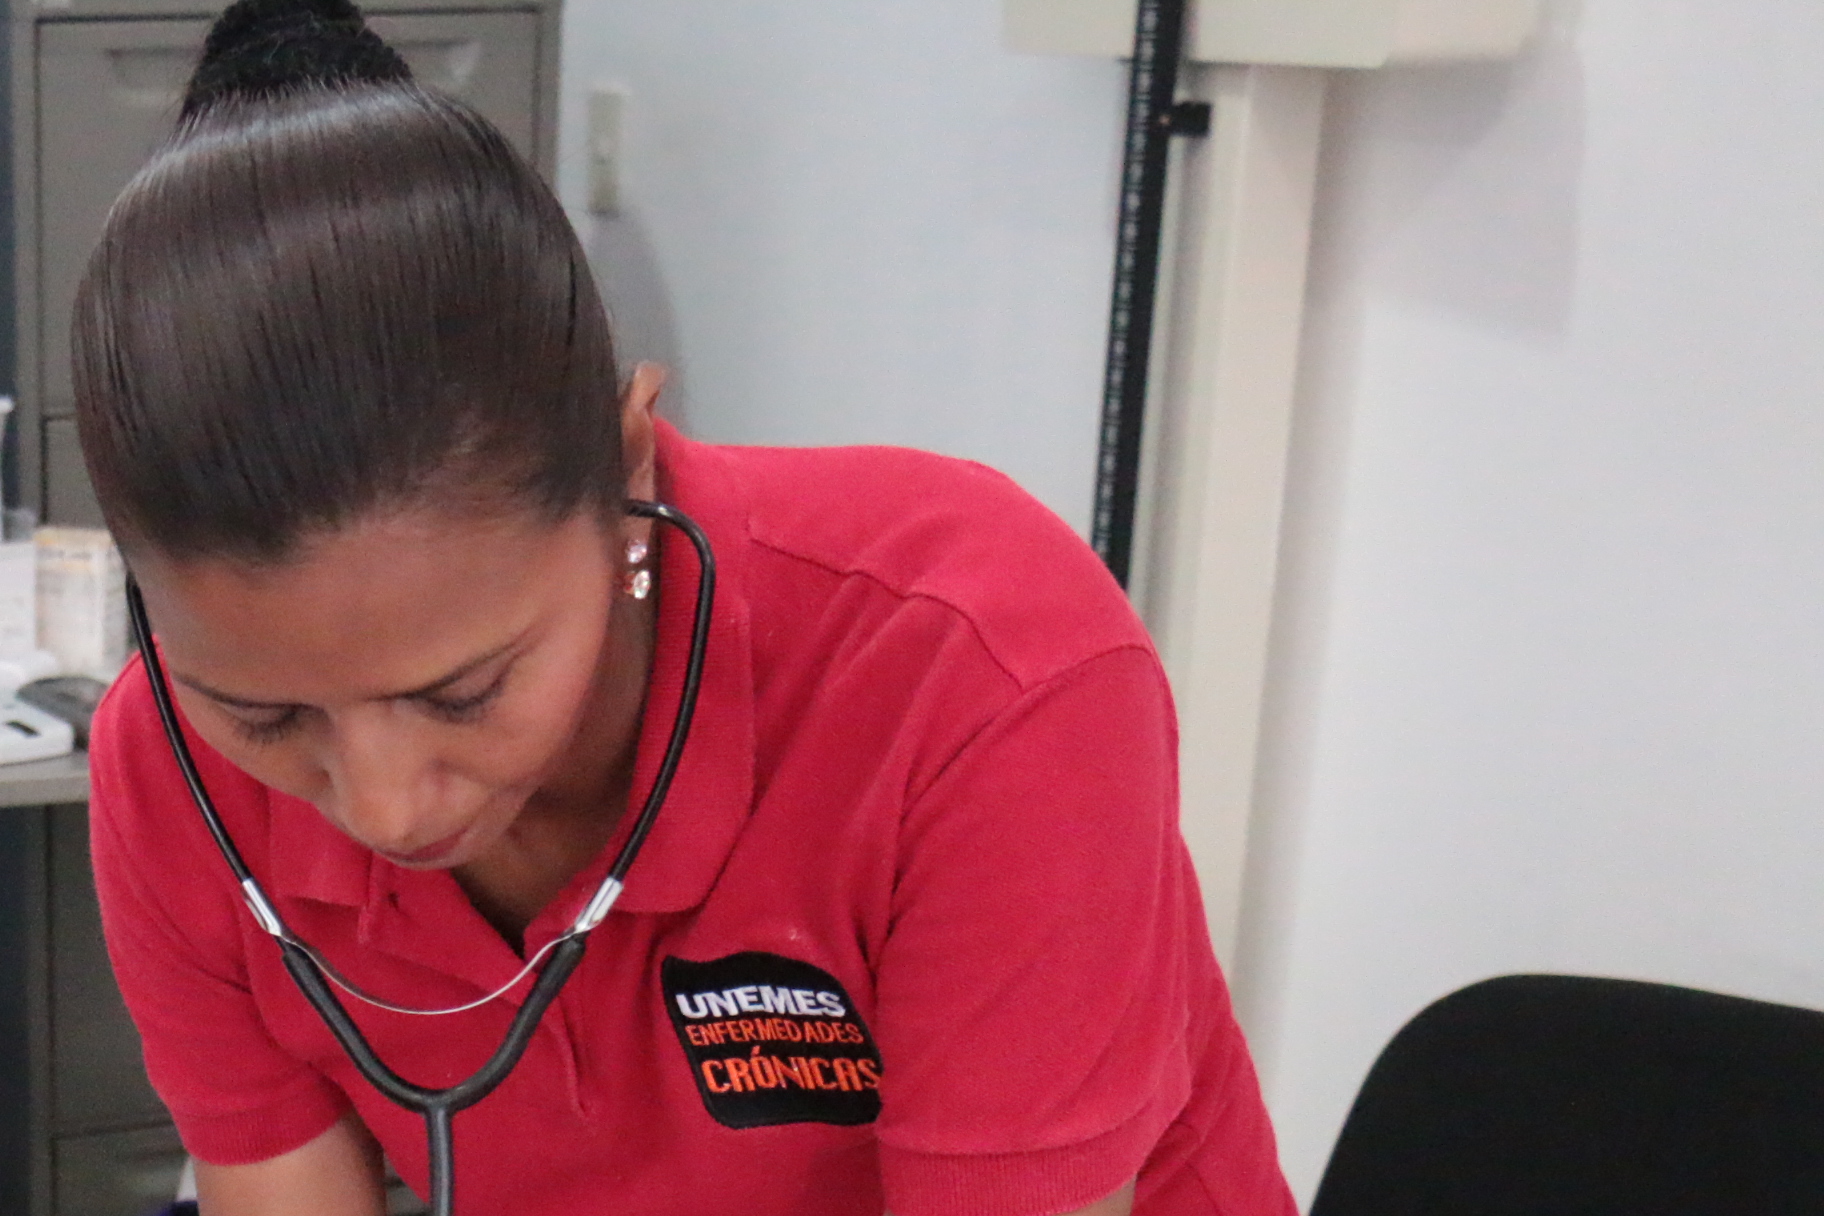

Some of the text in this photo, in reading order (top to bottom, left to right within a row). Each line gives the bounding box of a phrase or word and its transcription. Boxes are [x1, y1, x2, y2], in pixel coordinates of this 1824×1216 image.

[676, 985, 846, 1018] UNEMES
[684, 1018, 864, 1046] ENFERMEDADES
[701, 1045, 880, 1093] CRÓNICAS
